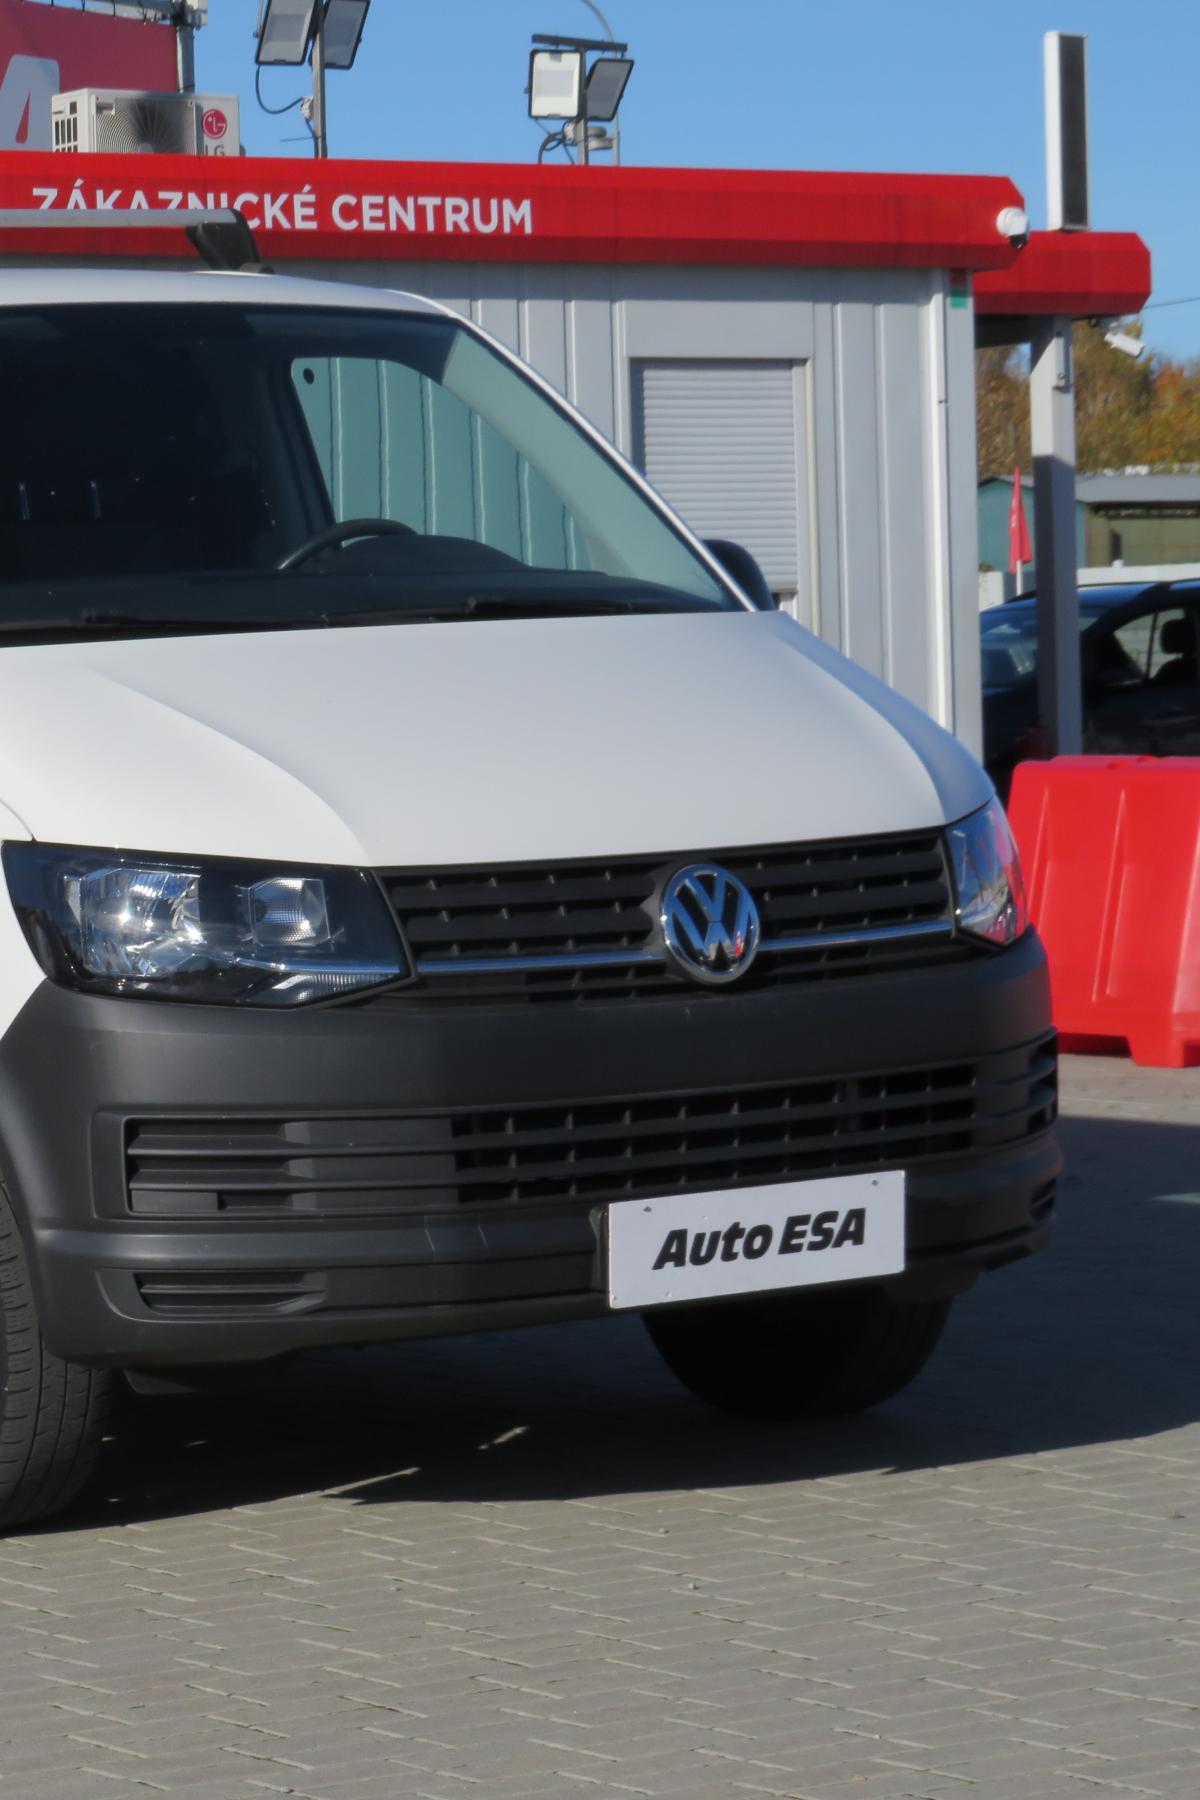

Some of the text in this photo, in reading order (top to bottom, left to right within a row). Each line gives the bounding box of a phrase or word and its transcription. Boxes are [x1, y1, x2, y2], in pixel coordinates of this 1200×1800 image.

[331, 193, 533, 234] CENTRUM
[652, 1208, 866, 1270] Auto ESA
